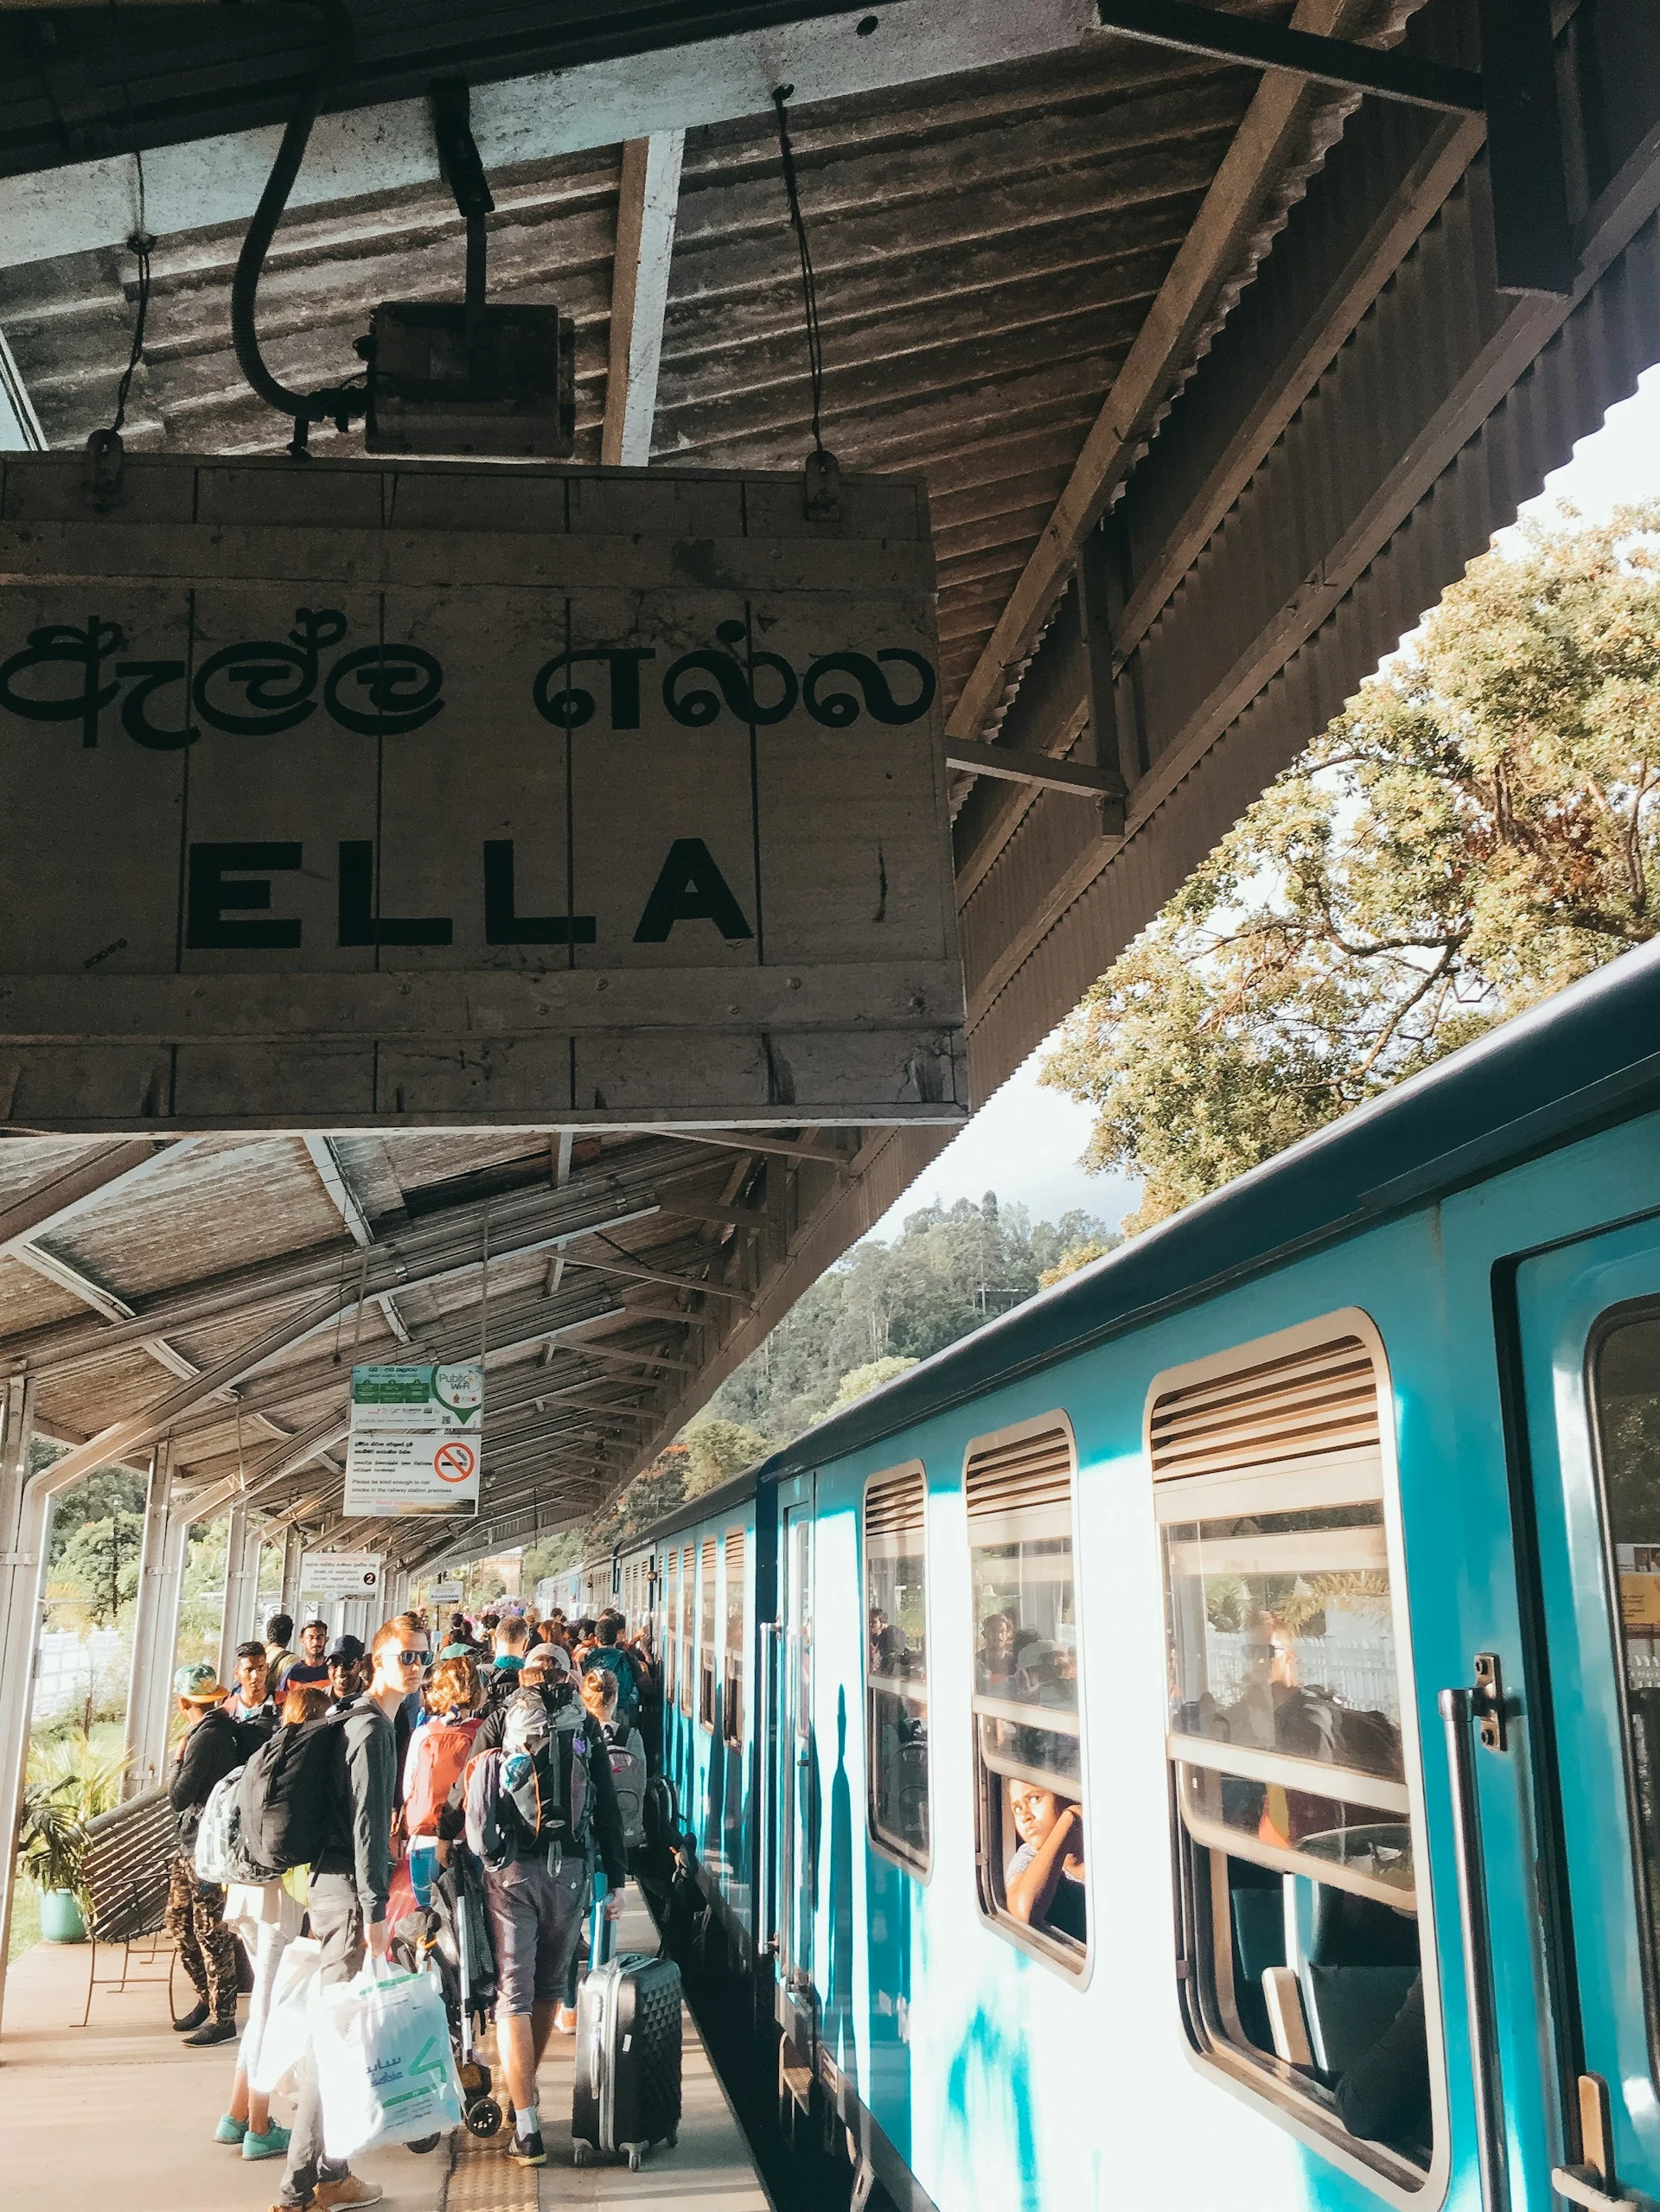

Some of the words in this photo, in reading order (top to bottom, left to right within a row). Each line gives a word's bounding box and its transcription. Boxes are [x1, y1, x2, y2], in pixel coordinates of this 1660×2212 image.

[0, 609, 444, 751] ඇල්ල
[533, 620, 937, 731] எல்ல
[185, 838, 755, 949] ELLA
[439, 1373, 469, 1383] Public
[366, 1574, 374, 1584] 2
